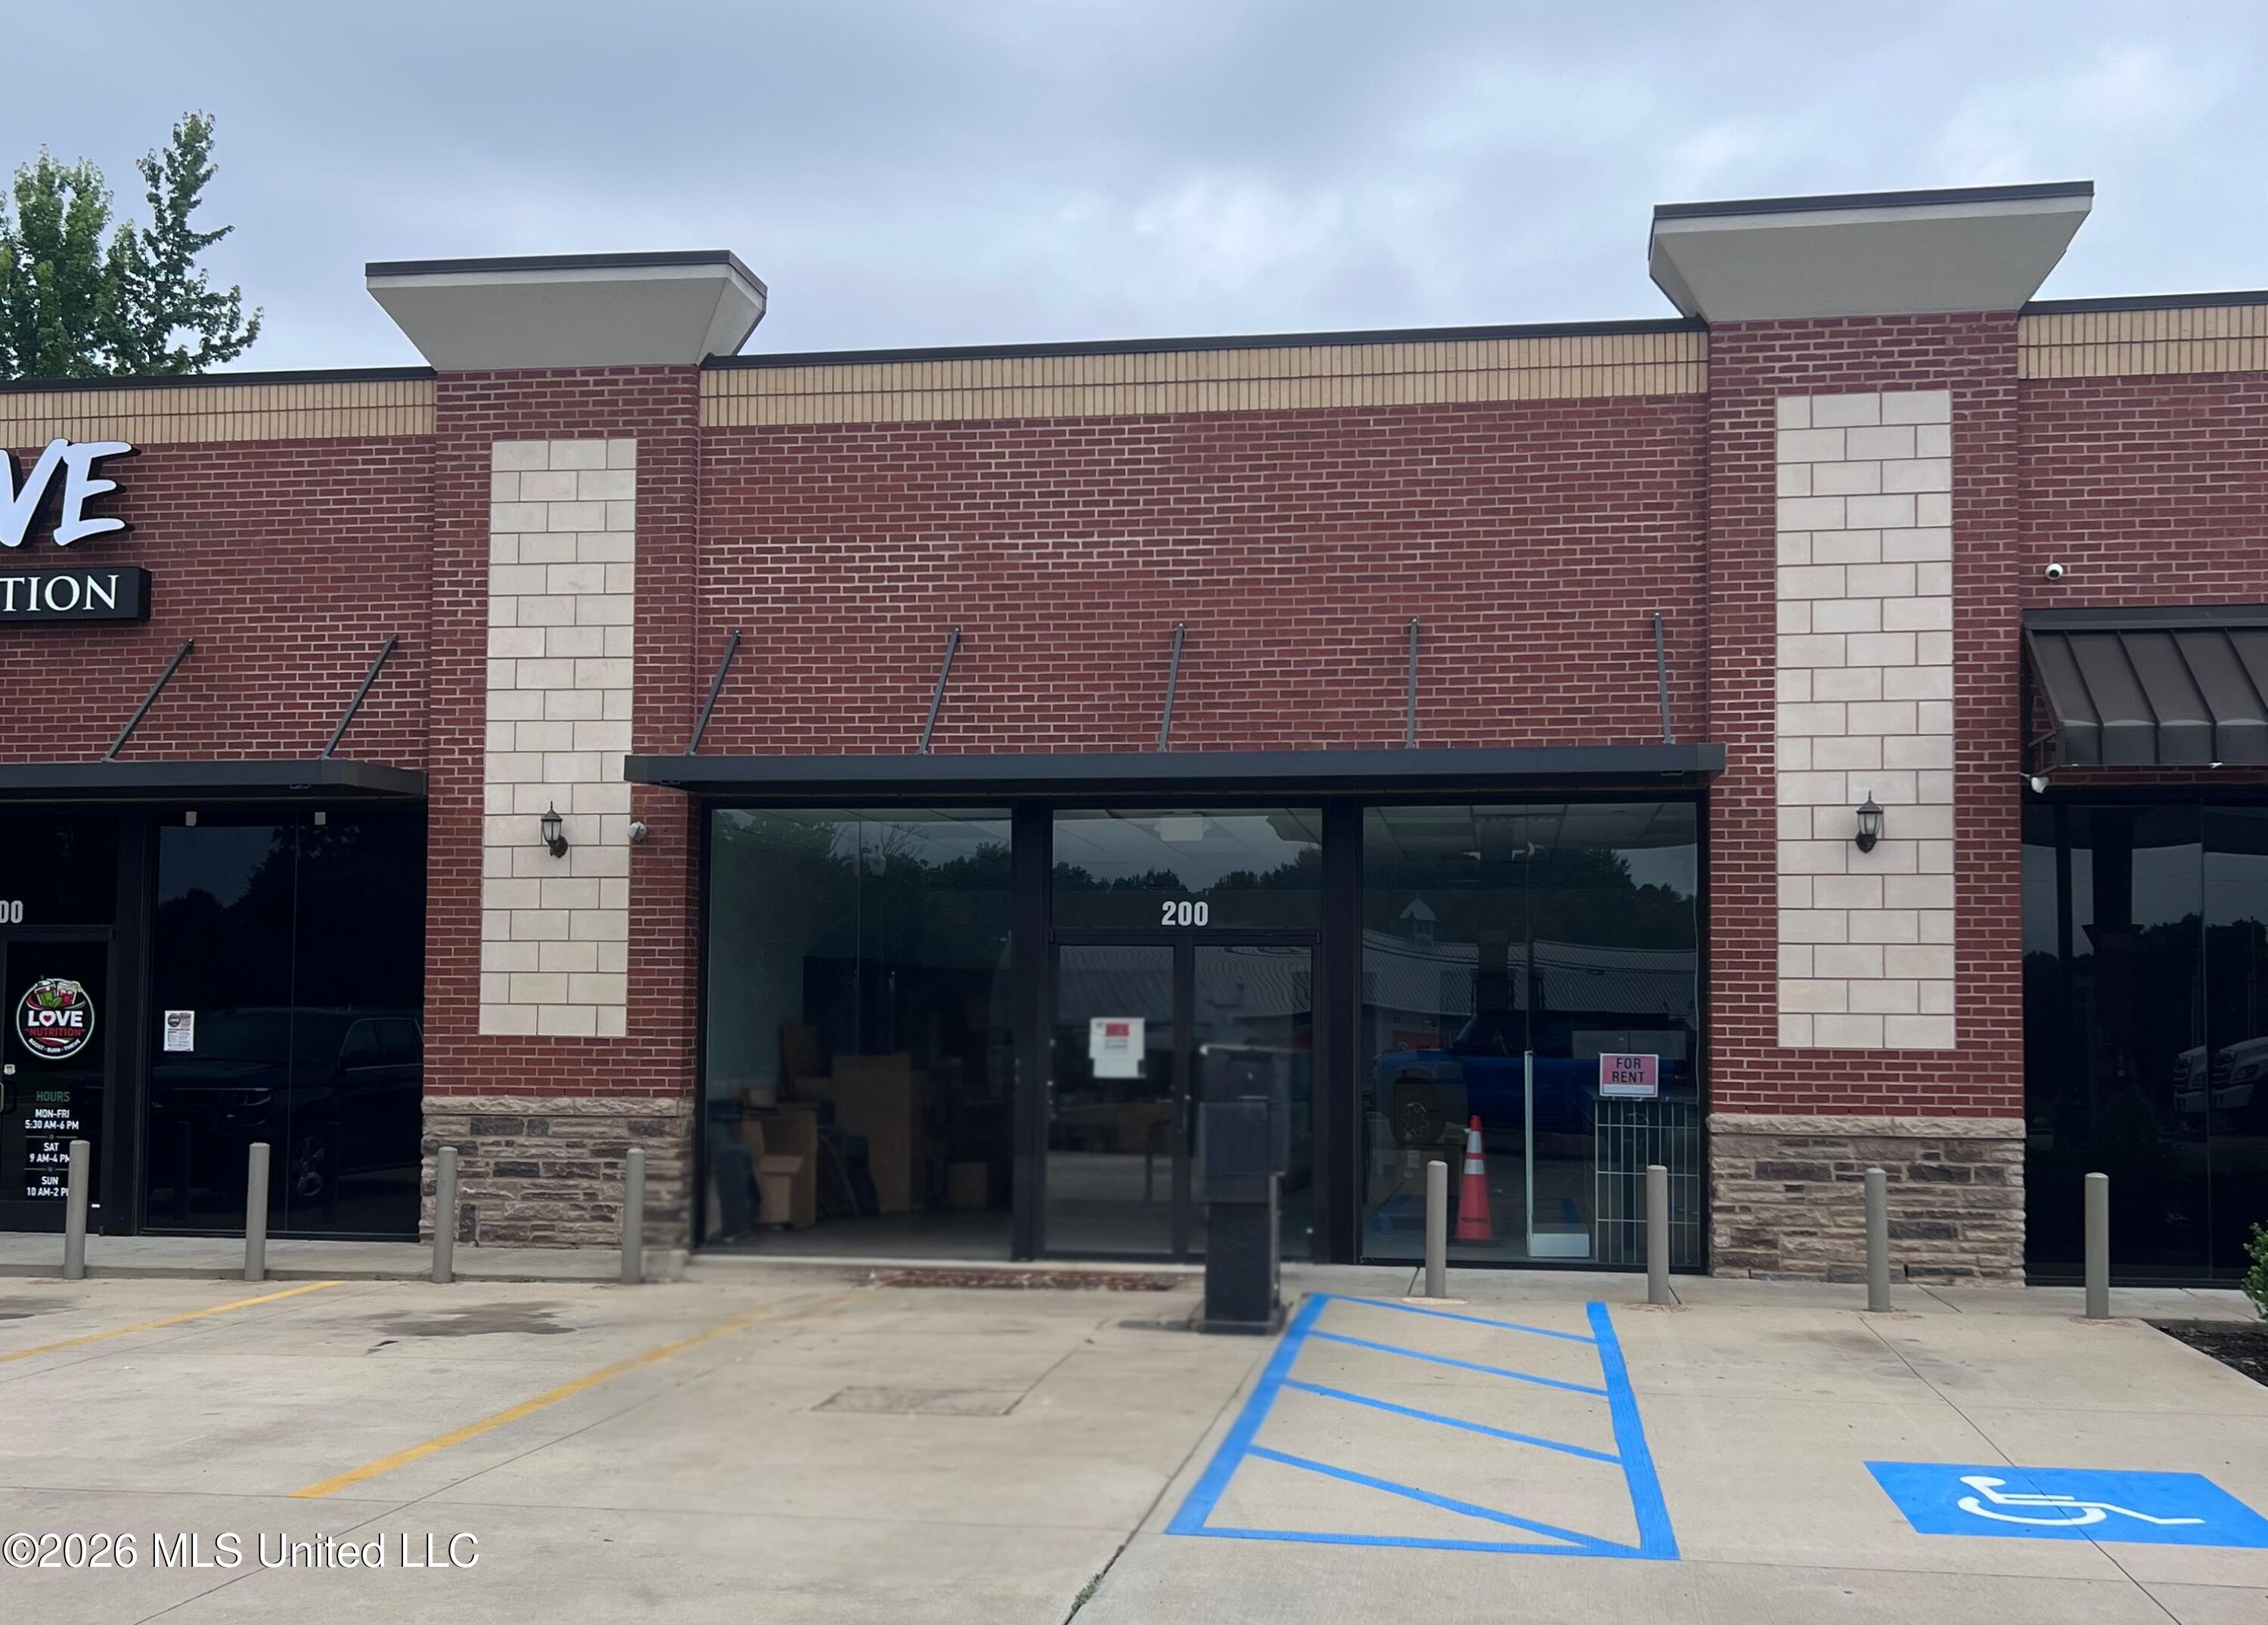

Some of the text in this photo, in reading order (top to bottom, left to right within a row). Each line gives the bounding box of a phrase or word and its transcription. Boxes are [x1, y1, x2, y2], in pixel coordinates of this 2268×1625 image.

[1162, 901, 1208, 926] 200
[27, 1010, 83, 1027] LOVE
[29, 1028, 82, 1037] NUTRITION
[1616, 1058, 1641, 1069] FOR
[1612, 1071, 1644, 1083] RENT
[36, 1091, 70, 1102] HOURS
[35, 1109, 70, 1118] MON-FRI
[25, 1120, 79, 1130] 5:30 AM-6 PM
[43, 1143, 60, 1152] SAT
[29, 1153, 35, 1162] 9
[36, 1154, 58, 1162] AM-4
[41, 1177, 58, 1185] SUN
[26, 1187, 69, 1196] 10 AM-2 P
